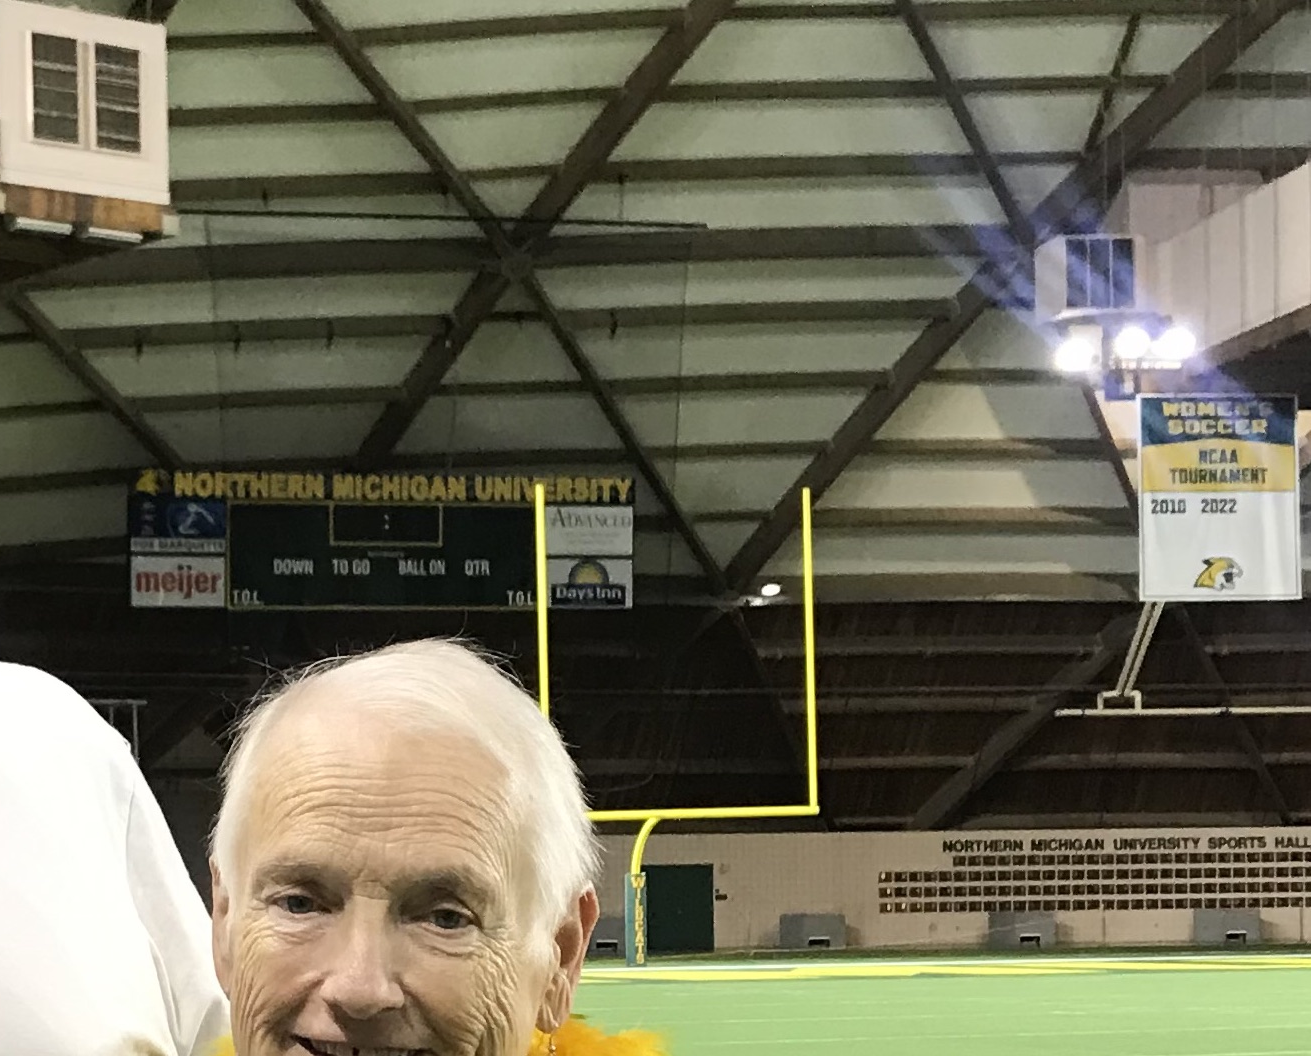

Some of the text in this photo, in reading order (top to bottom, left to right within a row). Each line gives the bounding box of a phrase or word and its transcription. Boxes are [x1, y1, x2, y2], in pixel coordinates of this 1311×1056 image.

[1168, 419, 1268, 435] SOCCER
[1199, 448, 1238, 464] NCAA
[1169, 467, 1268, 485] TOURNAMENT
[174, 471, 632, 502] NORTHERN MICHIGAN UNIVERSITY
[1151, 498, 1237, 514] 2010 2022
[273, 559, 490, 576] DOWN TO GO BALL ON QTR
[135, 564, 222, 599] meijer
[555, 586, 622, 601] Days Inn
[942, 839, 1024, 853] NORTHERN
[1030, 837, 1104, 851] MICHIGAN
[1113, 837, 1201, 851] UNIVERSITY
[1207, 836, 1267, 850] SPORTS
[631, 876, 644, 964] WILDCATS
